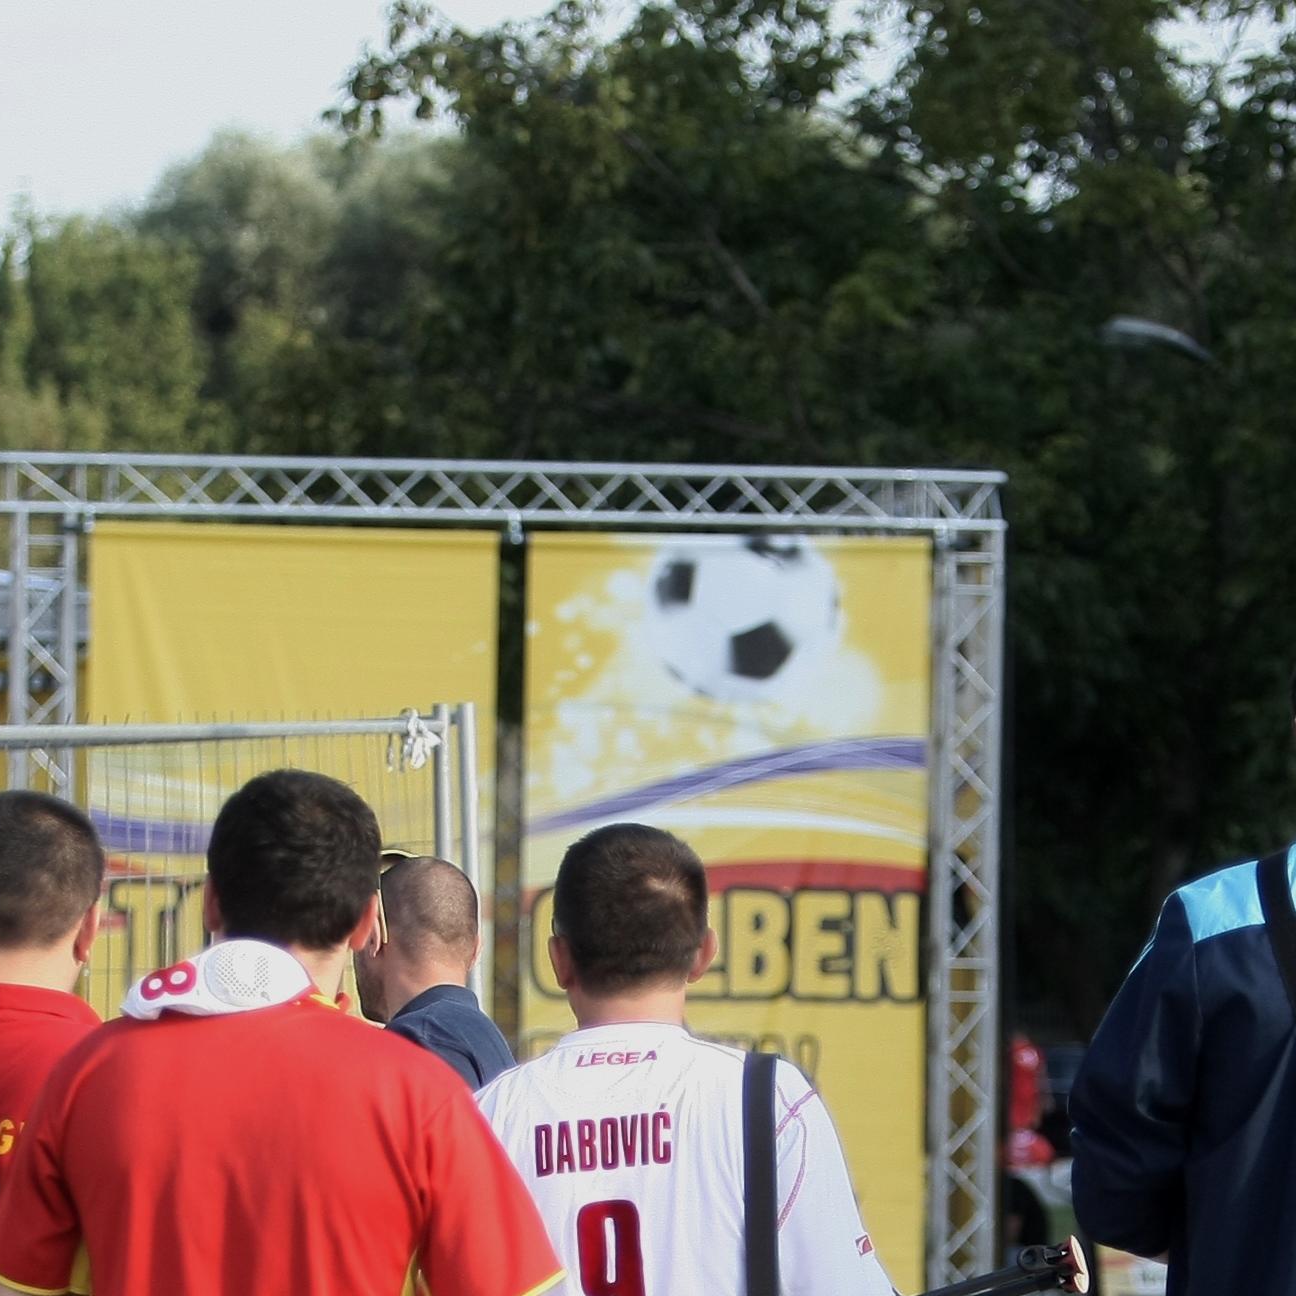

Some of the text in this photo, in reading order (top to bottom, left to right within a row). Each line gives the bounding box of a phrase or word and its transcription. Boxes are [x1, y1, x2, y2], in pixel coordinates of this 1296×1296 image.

[140, 960, 197, 1001] 8
[575, 1050, 658, 1068] LEGEA
[534, 1103, 672, 1178] DABOVIĆ
